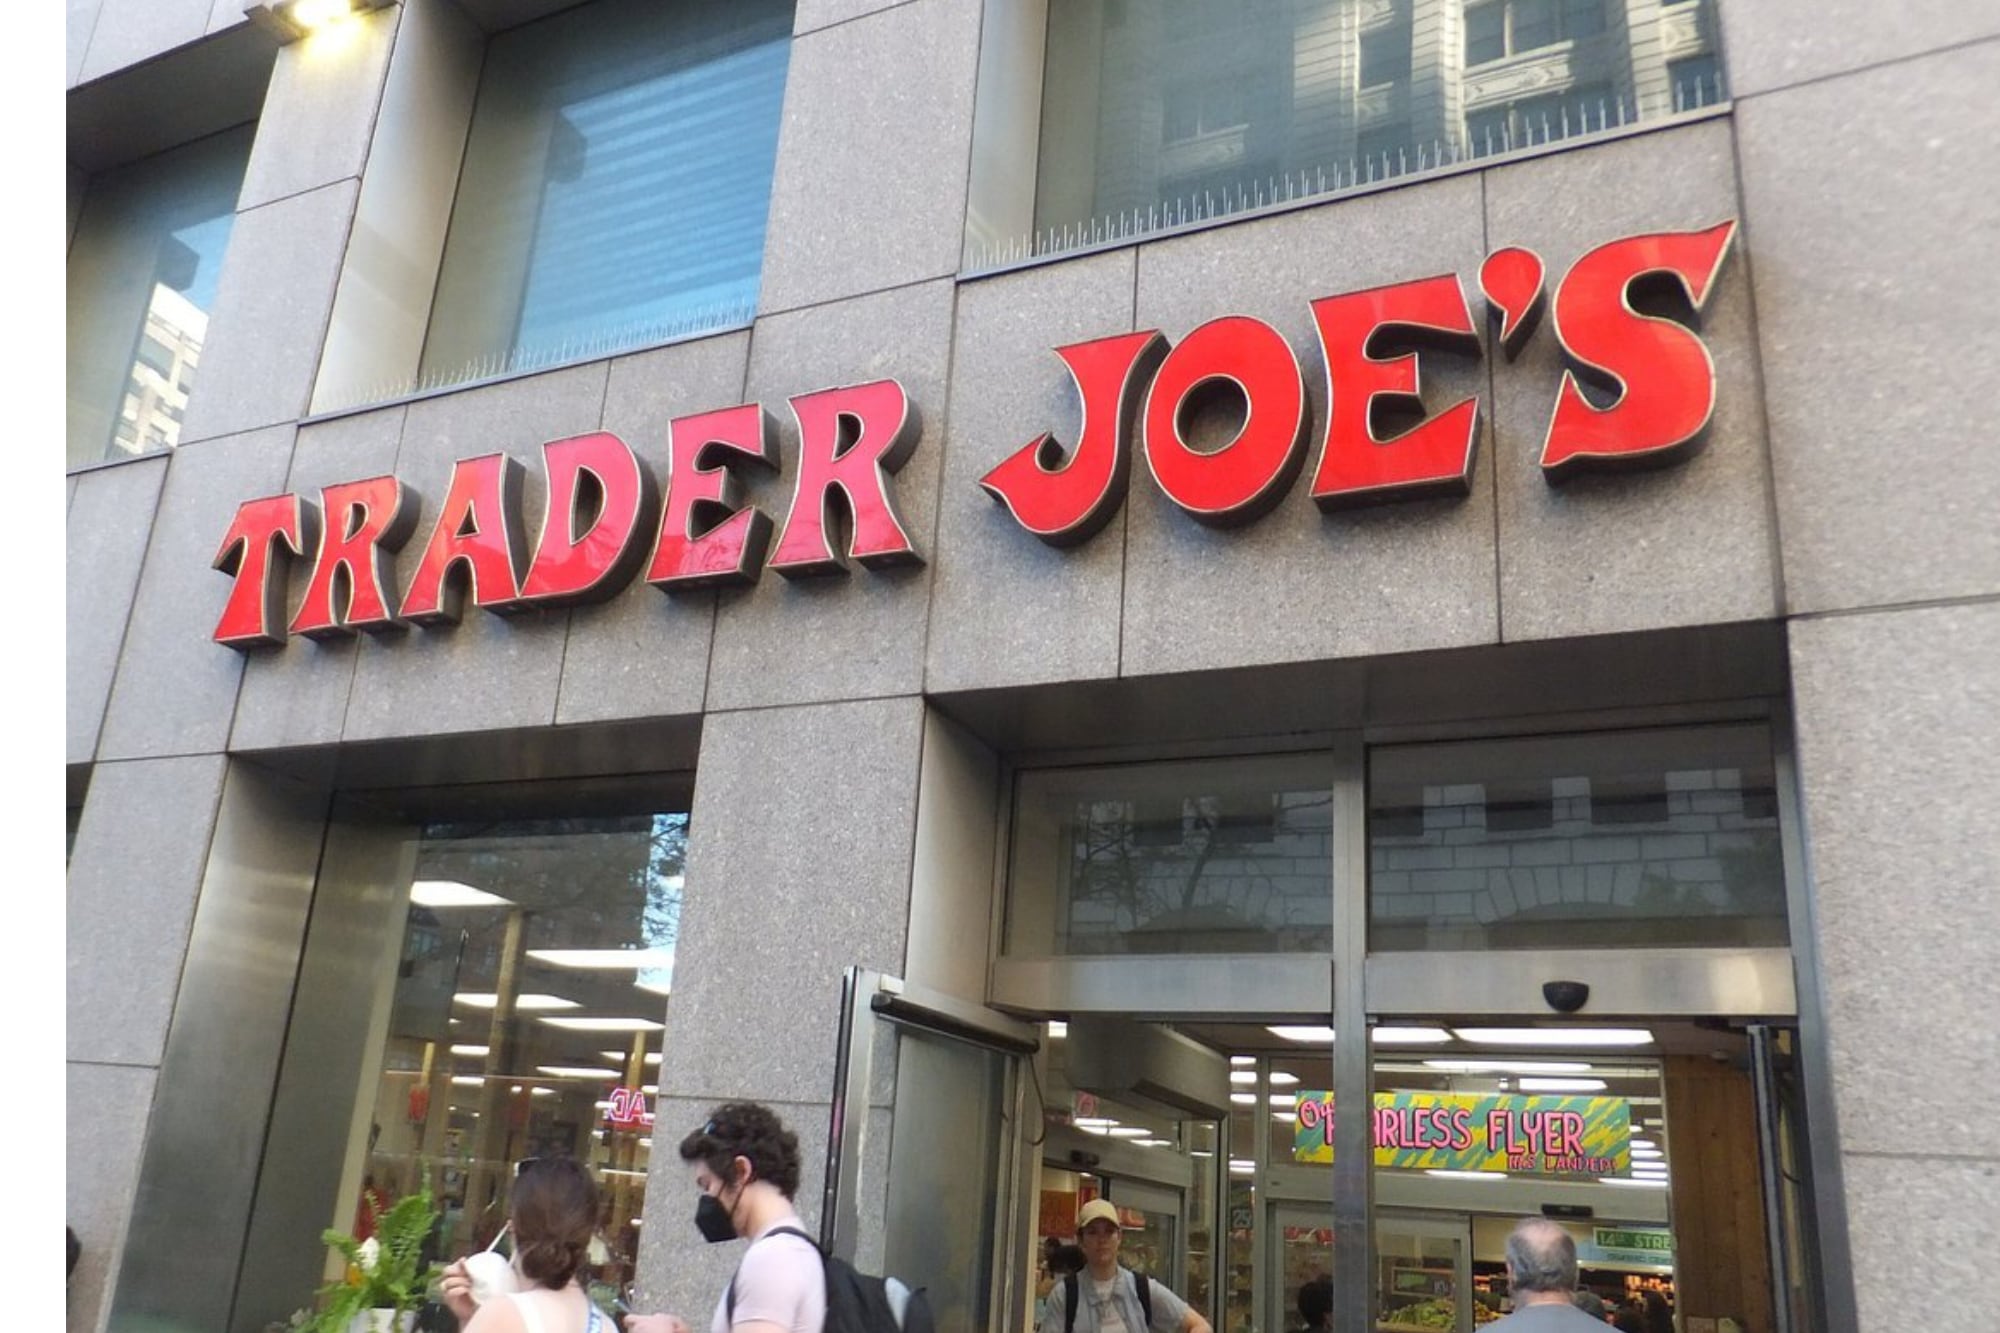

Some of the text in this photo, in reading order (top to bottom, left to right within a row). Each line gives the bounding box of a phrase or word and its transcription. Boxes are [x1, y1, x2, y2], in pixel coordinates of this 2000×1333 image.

[213, 219, 1739, 643] TRADER JOE'S
[1299, 1100, 1334, 1128] Ou
[1324, 1107, 1585, 1155] FRLESS FLYER
[1633, 1235, 1671, 1249] STRE
